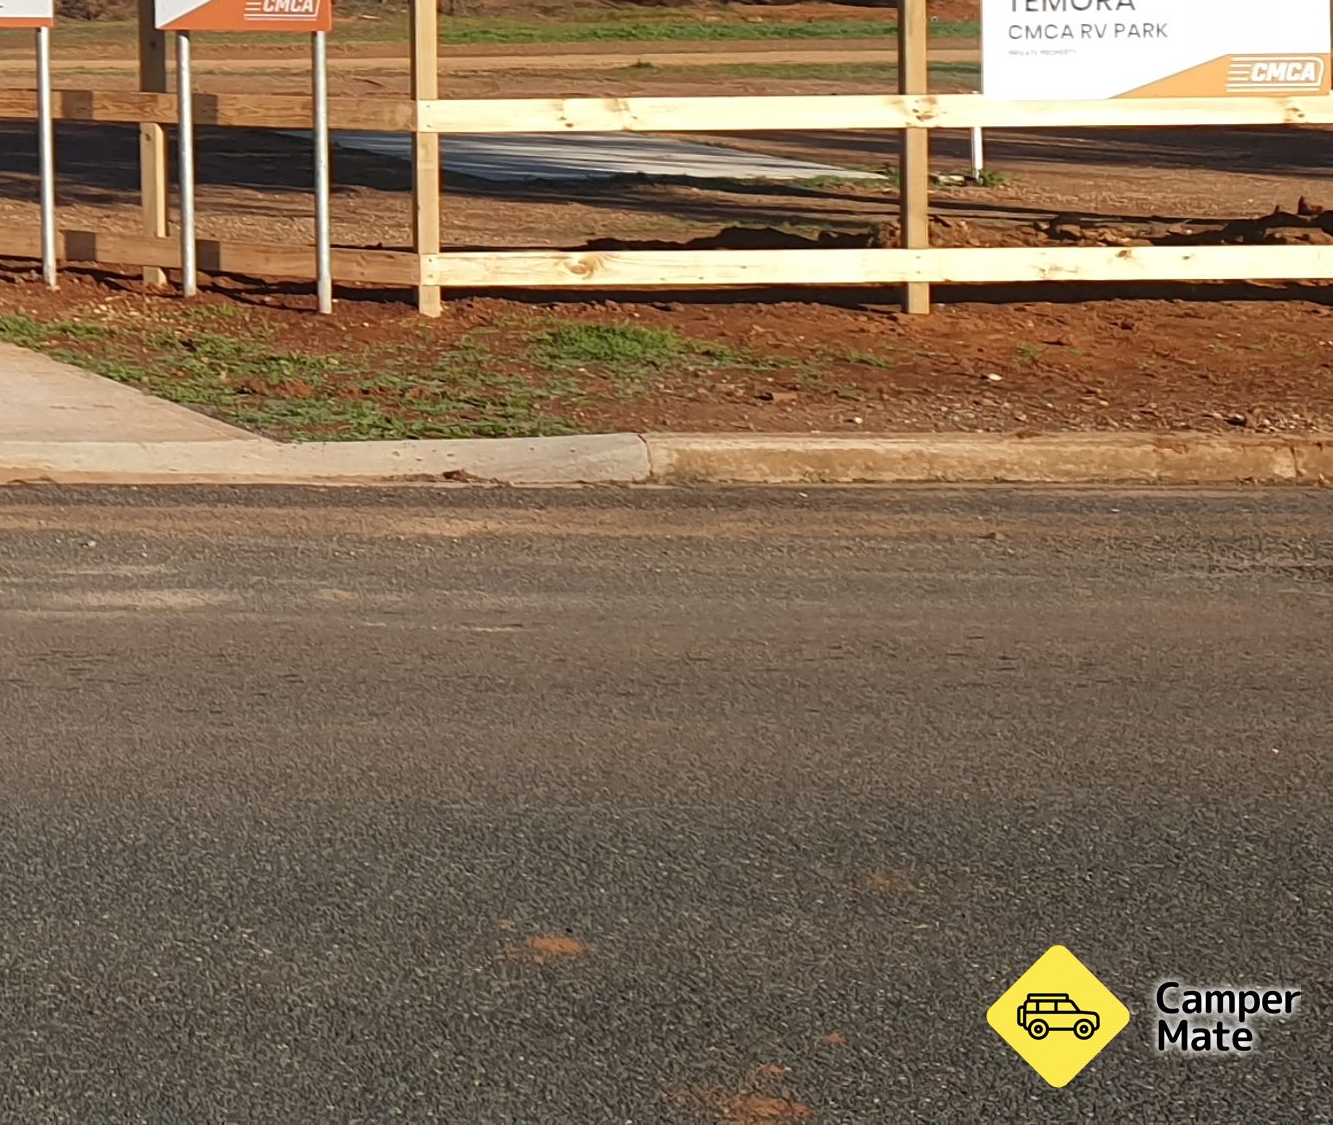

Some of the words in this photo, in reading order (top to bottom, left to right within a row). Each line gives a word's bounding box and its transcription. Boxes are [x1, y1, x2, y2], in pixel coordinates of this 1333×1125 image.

[1008, 23, 1074, 40] CMCA
[1081, 23, 1108, 39] RV
[1114, 22, 1169, 39] PARK
[1251, 62, 1317, 83] CMCA
